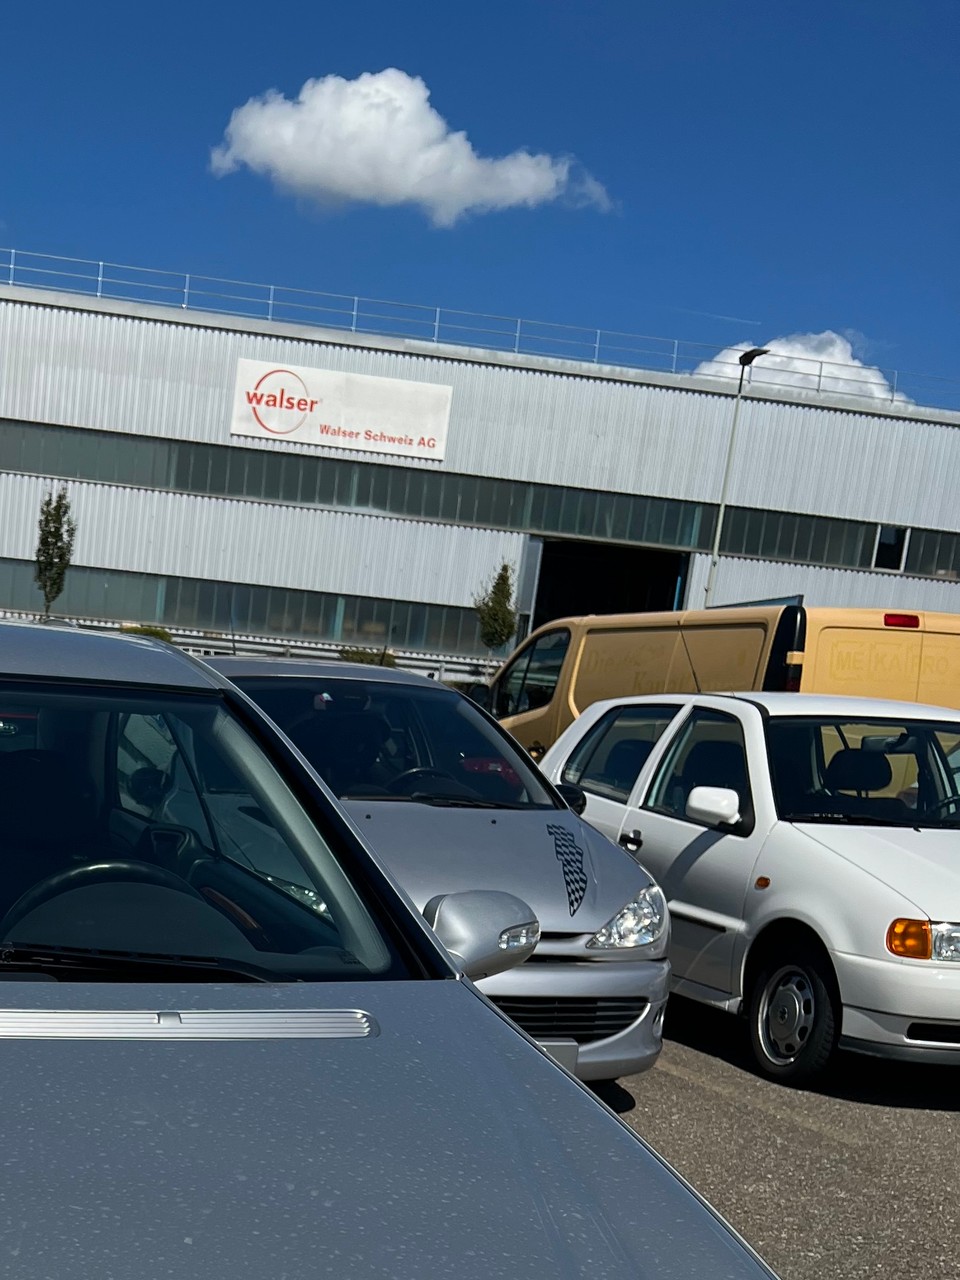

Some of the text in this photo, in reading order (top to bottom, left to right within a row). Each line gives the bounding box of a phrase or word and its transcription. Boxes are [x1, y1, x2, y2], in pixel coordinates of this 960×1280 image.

[246, 388, 318, 412] walser
[319, 424, 436, 448] Walser Schweiz AG
